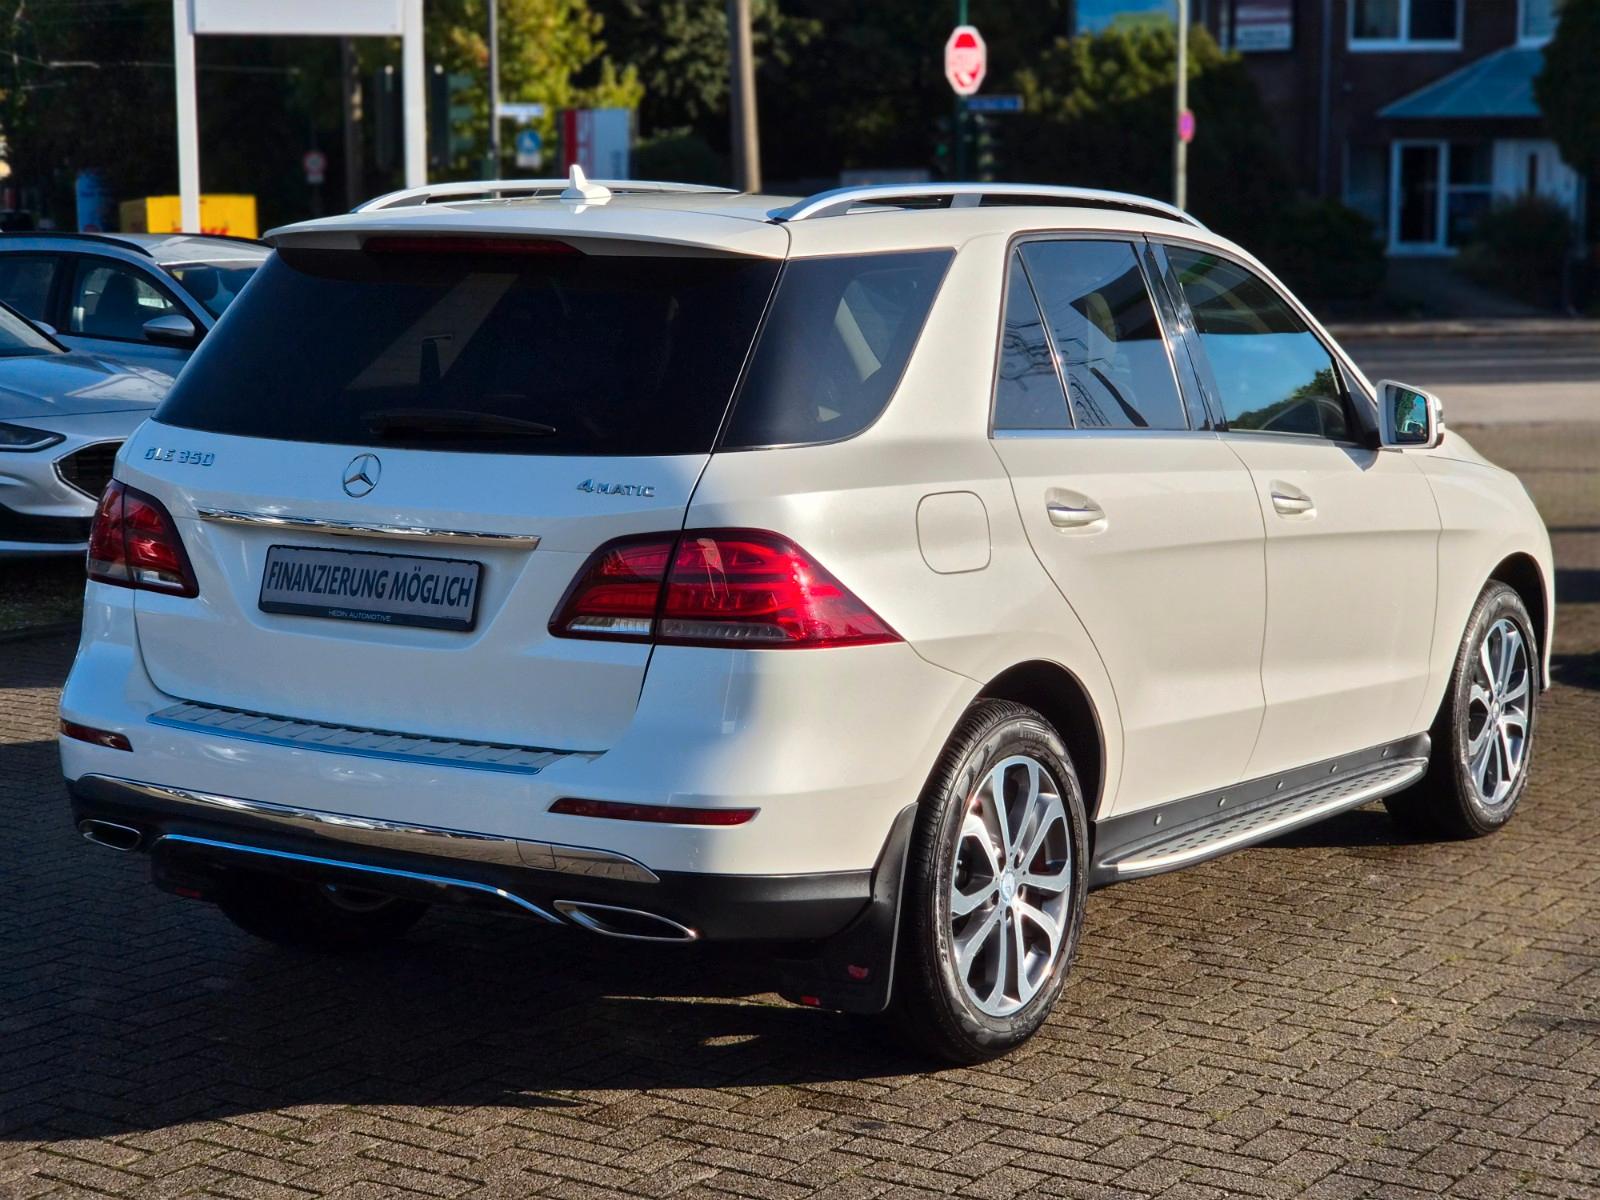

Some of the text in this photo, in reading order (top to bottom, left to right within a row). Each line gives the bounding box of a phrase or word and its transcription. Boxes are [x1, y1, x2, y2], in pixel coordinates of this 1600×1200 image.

[144, 447, 215, 466] GLE 350
[266, 561, 474, 607] FINANZIERUNG MÖGLICH
[328, 608, 392, 622] HEDIN AUTOMOTIVE
